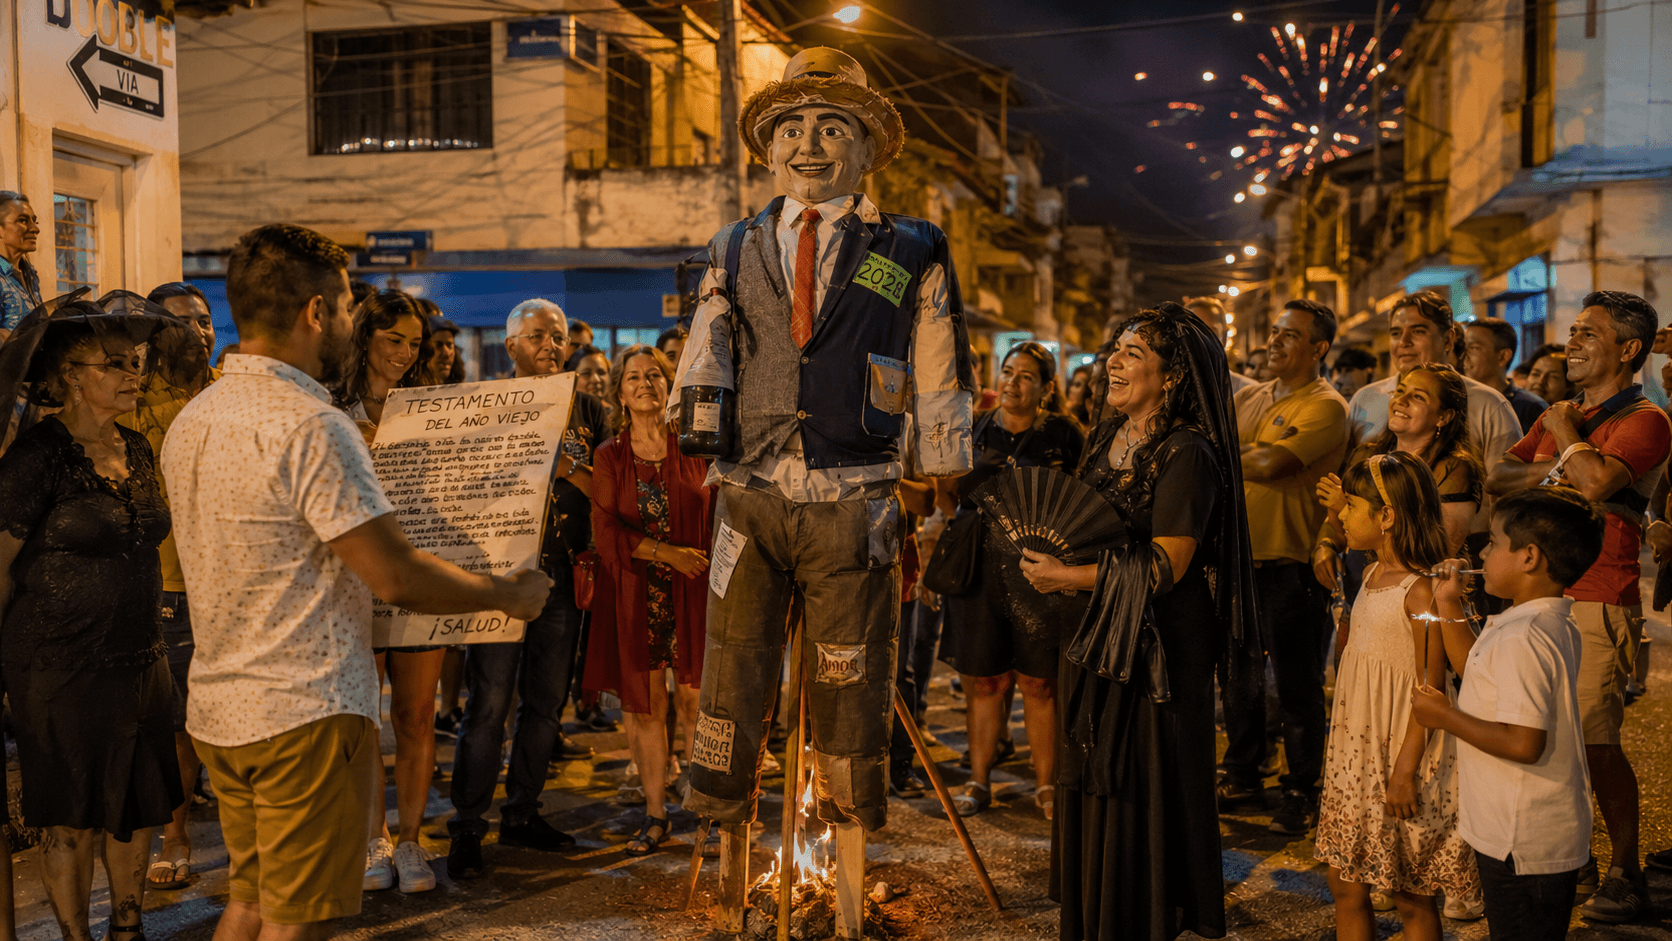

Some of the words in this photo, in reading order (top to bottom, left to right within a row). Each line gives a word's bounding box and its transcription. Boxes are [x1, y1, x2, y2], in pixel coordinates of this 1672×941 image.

[117, 69, 139, 95] VIA
[857, 262, 904, 299] 2028
[405, 390, 535, 415] TESTAMENTO
[425, 418, 453, 431] DEL
[458, 413, 489, 428] AÑO
[497, 410, 540, 425] VIEJO
[428, 615, 512, 641] ¡SALUD!
